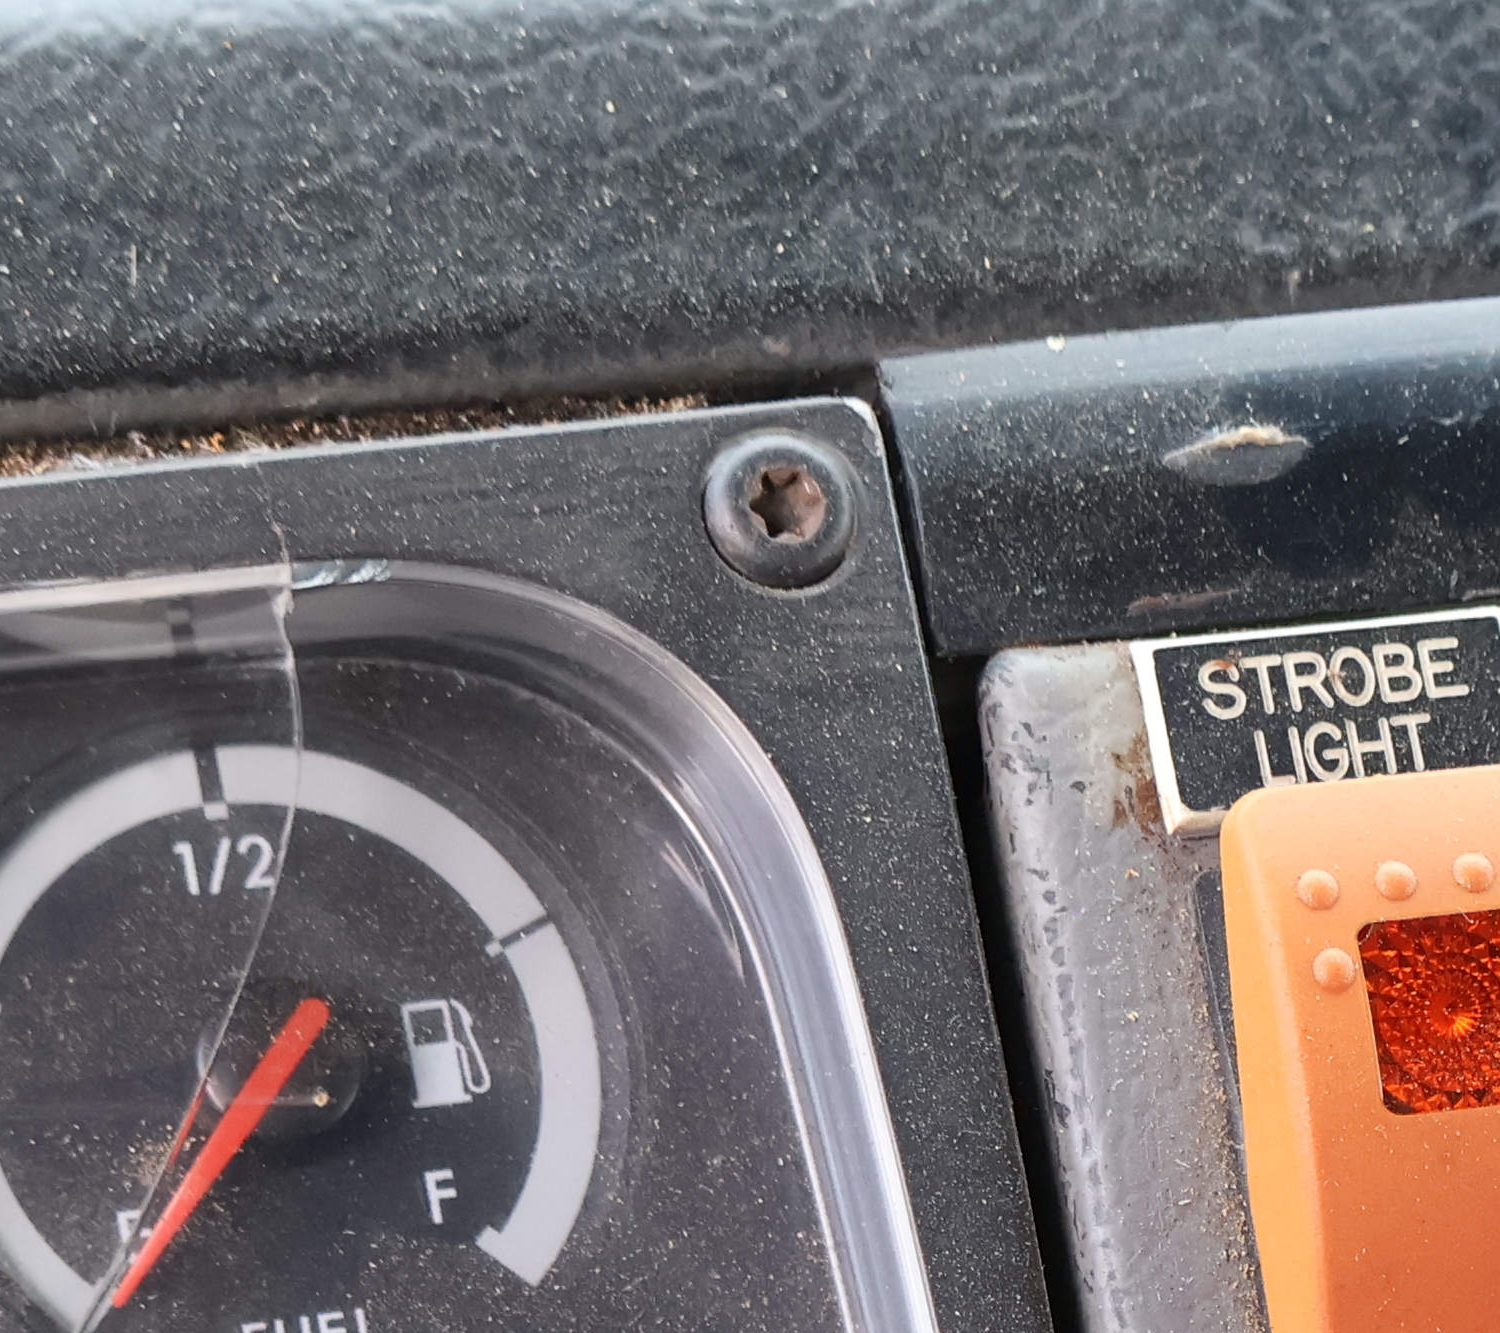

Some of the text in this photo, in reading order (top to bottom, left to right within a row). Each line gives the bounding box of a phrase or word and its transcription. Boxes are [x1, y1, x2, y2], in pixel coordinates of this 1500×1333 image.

[1199, 637, 1469, 720] STROBE
[1254, 713, 1431, 787] LIGHT
[173, 834, 276, 896] 1/2
[422, 1169, 457, 1224] F
